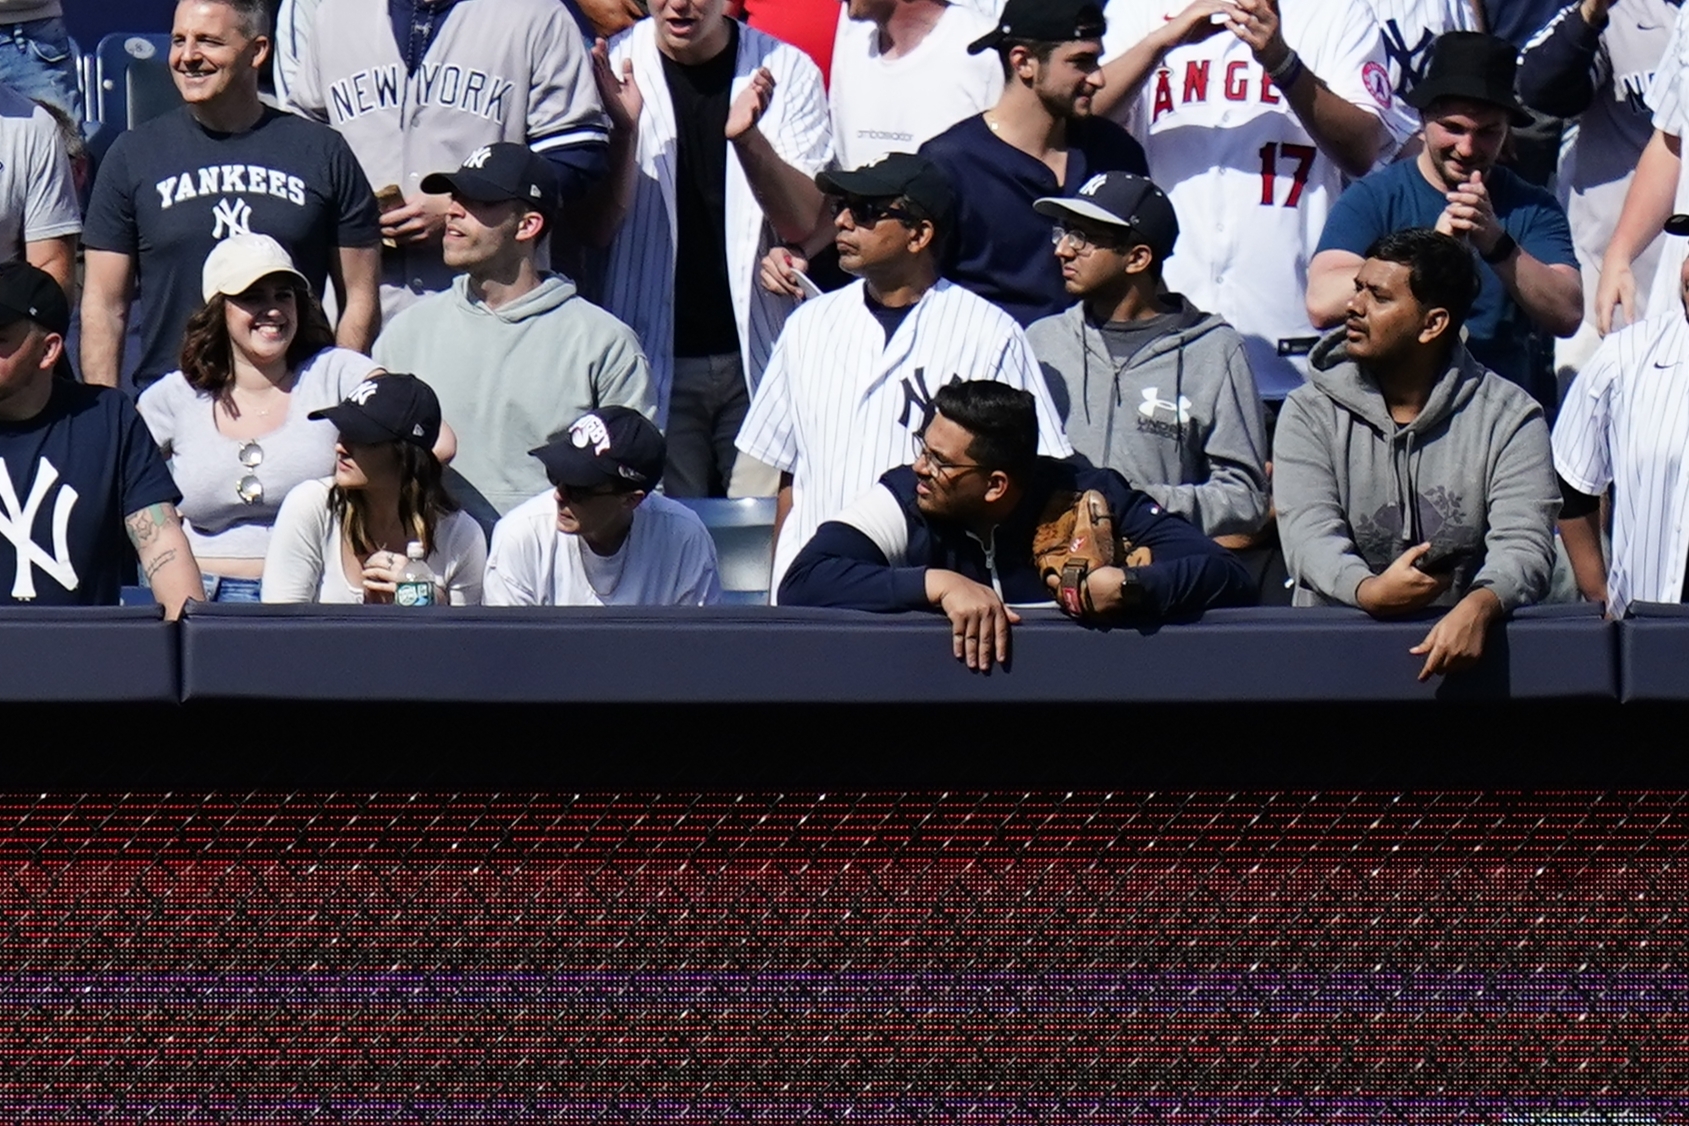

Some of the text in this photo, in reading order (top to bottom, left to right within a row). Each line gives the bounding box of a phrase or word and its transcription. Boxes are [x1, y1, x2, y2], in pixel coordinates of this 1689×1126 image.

[330, 60, 516, 126] NEW YORK
[1151, 59, 1282, 124] ANGE
[156, 164, 306, 209] YANKEES
[1259, 141, 1317, 208] 17
